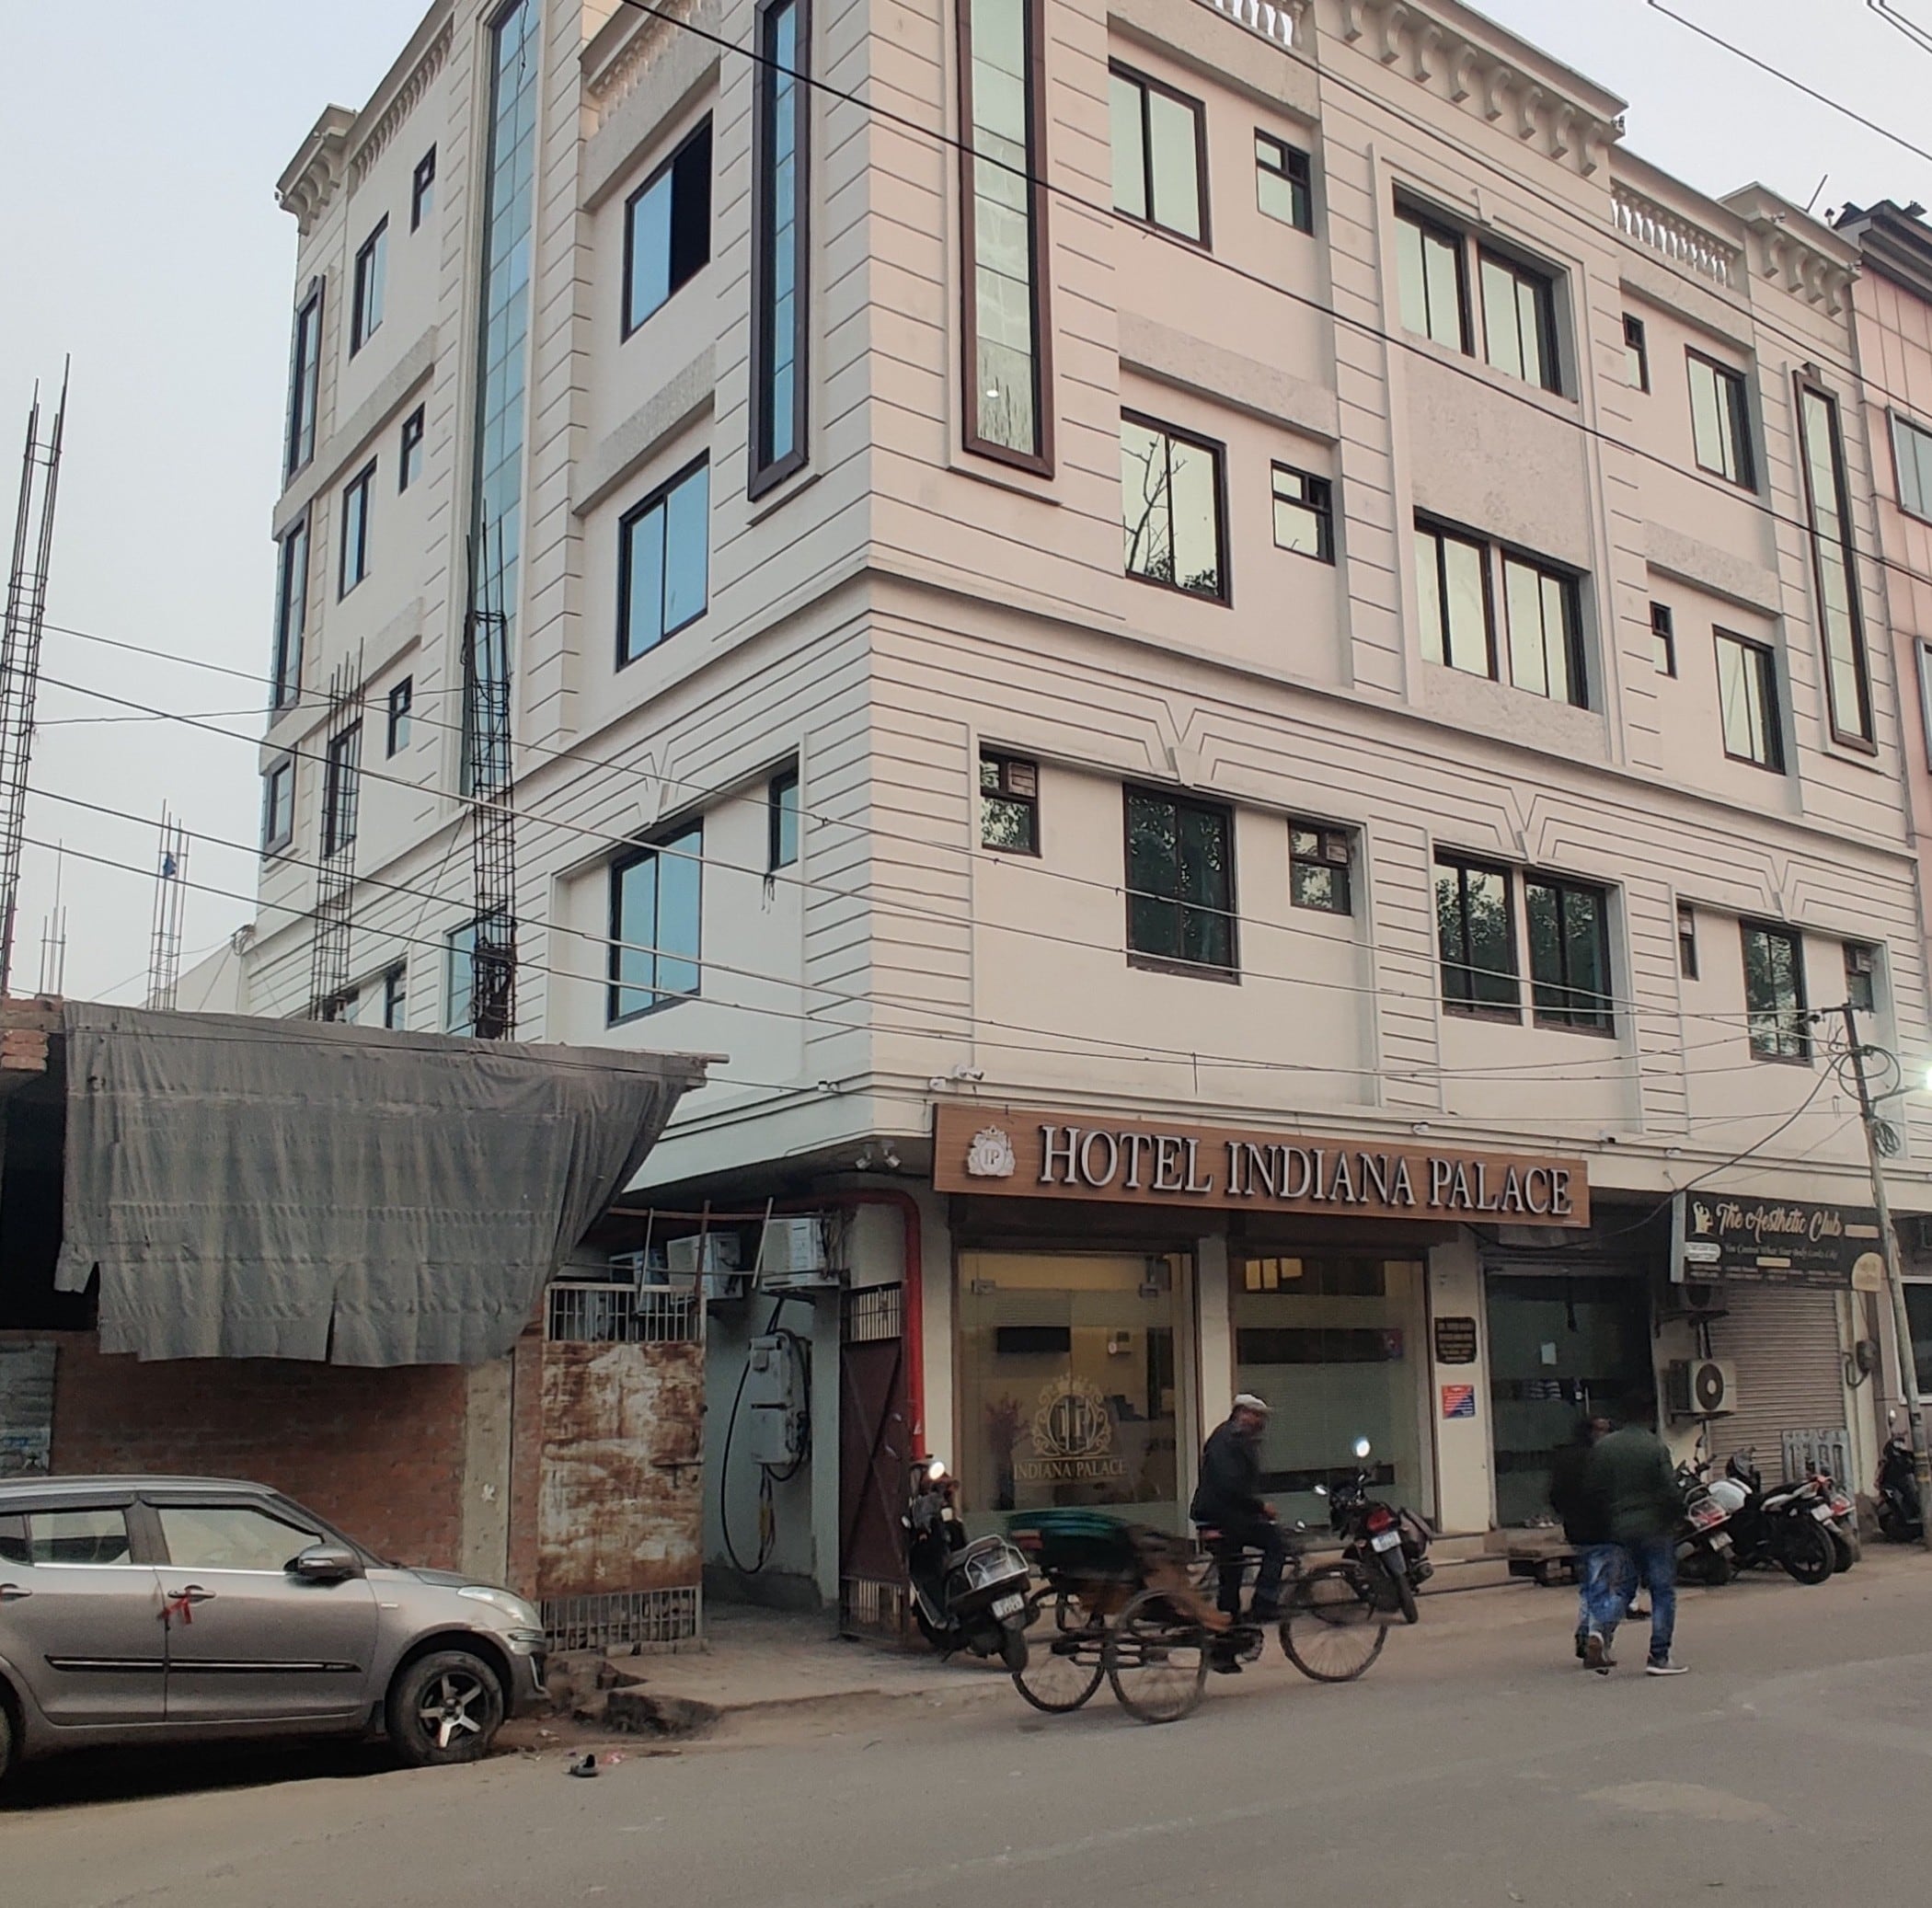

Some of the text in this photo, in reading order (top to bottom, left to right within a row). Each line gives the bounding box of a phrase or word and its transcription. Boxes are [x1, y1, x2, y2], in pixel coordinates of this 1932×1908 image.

[1040, 1124, 1572, 1215] HOTEL INDIANA PALACE
[1716, 1201, 1843, 1243] The Aesthetic Club
[1014, 1458, 1127, 1479] INDIANA PALACE
